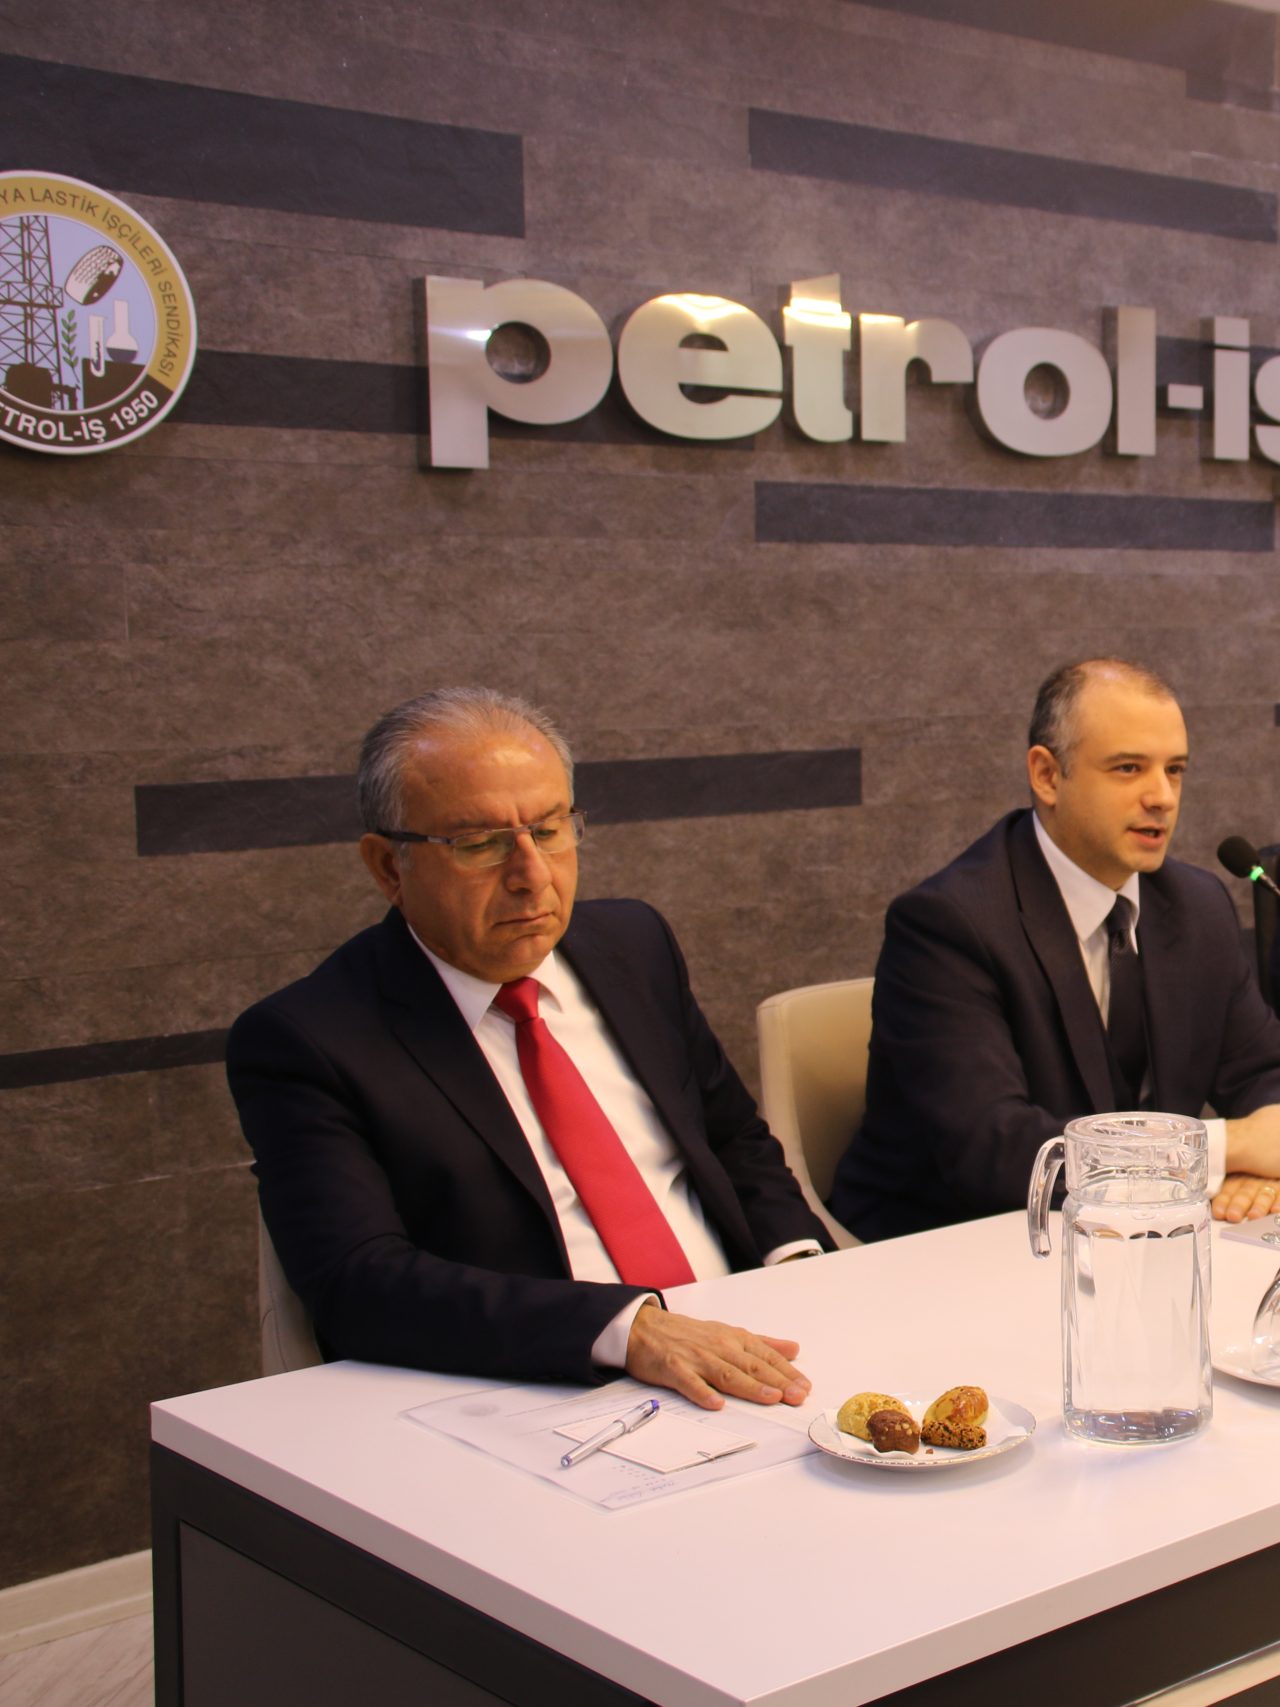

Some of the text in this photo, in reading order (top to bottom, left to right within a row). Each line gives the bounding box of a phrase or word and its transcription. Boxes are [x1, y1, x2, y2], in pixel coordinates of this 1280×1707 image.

[30, 187, 100, 218] LASTİK
[102, 207, 168, 276] İŞÇİLERİ
[158, 280, 182, 378] SENDİKASI
[0, 390, 159, 444] TROL-İŞ 1950
